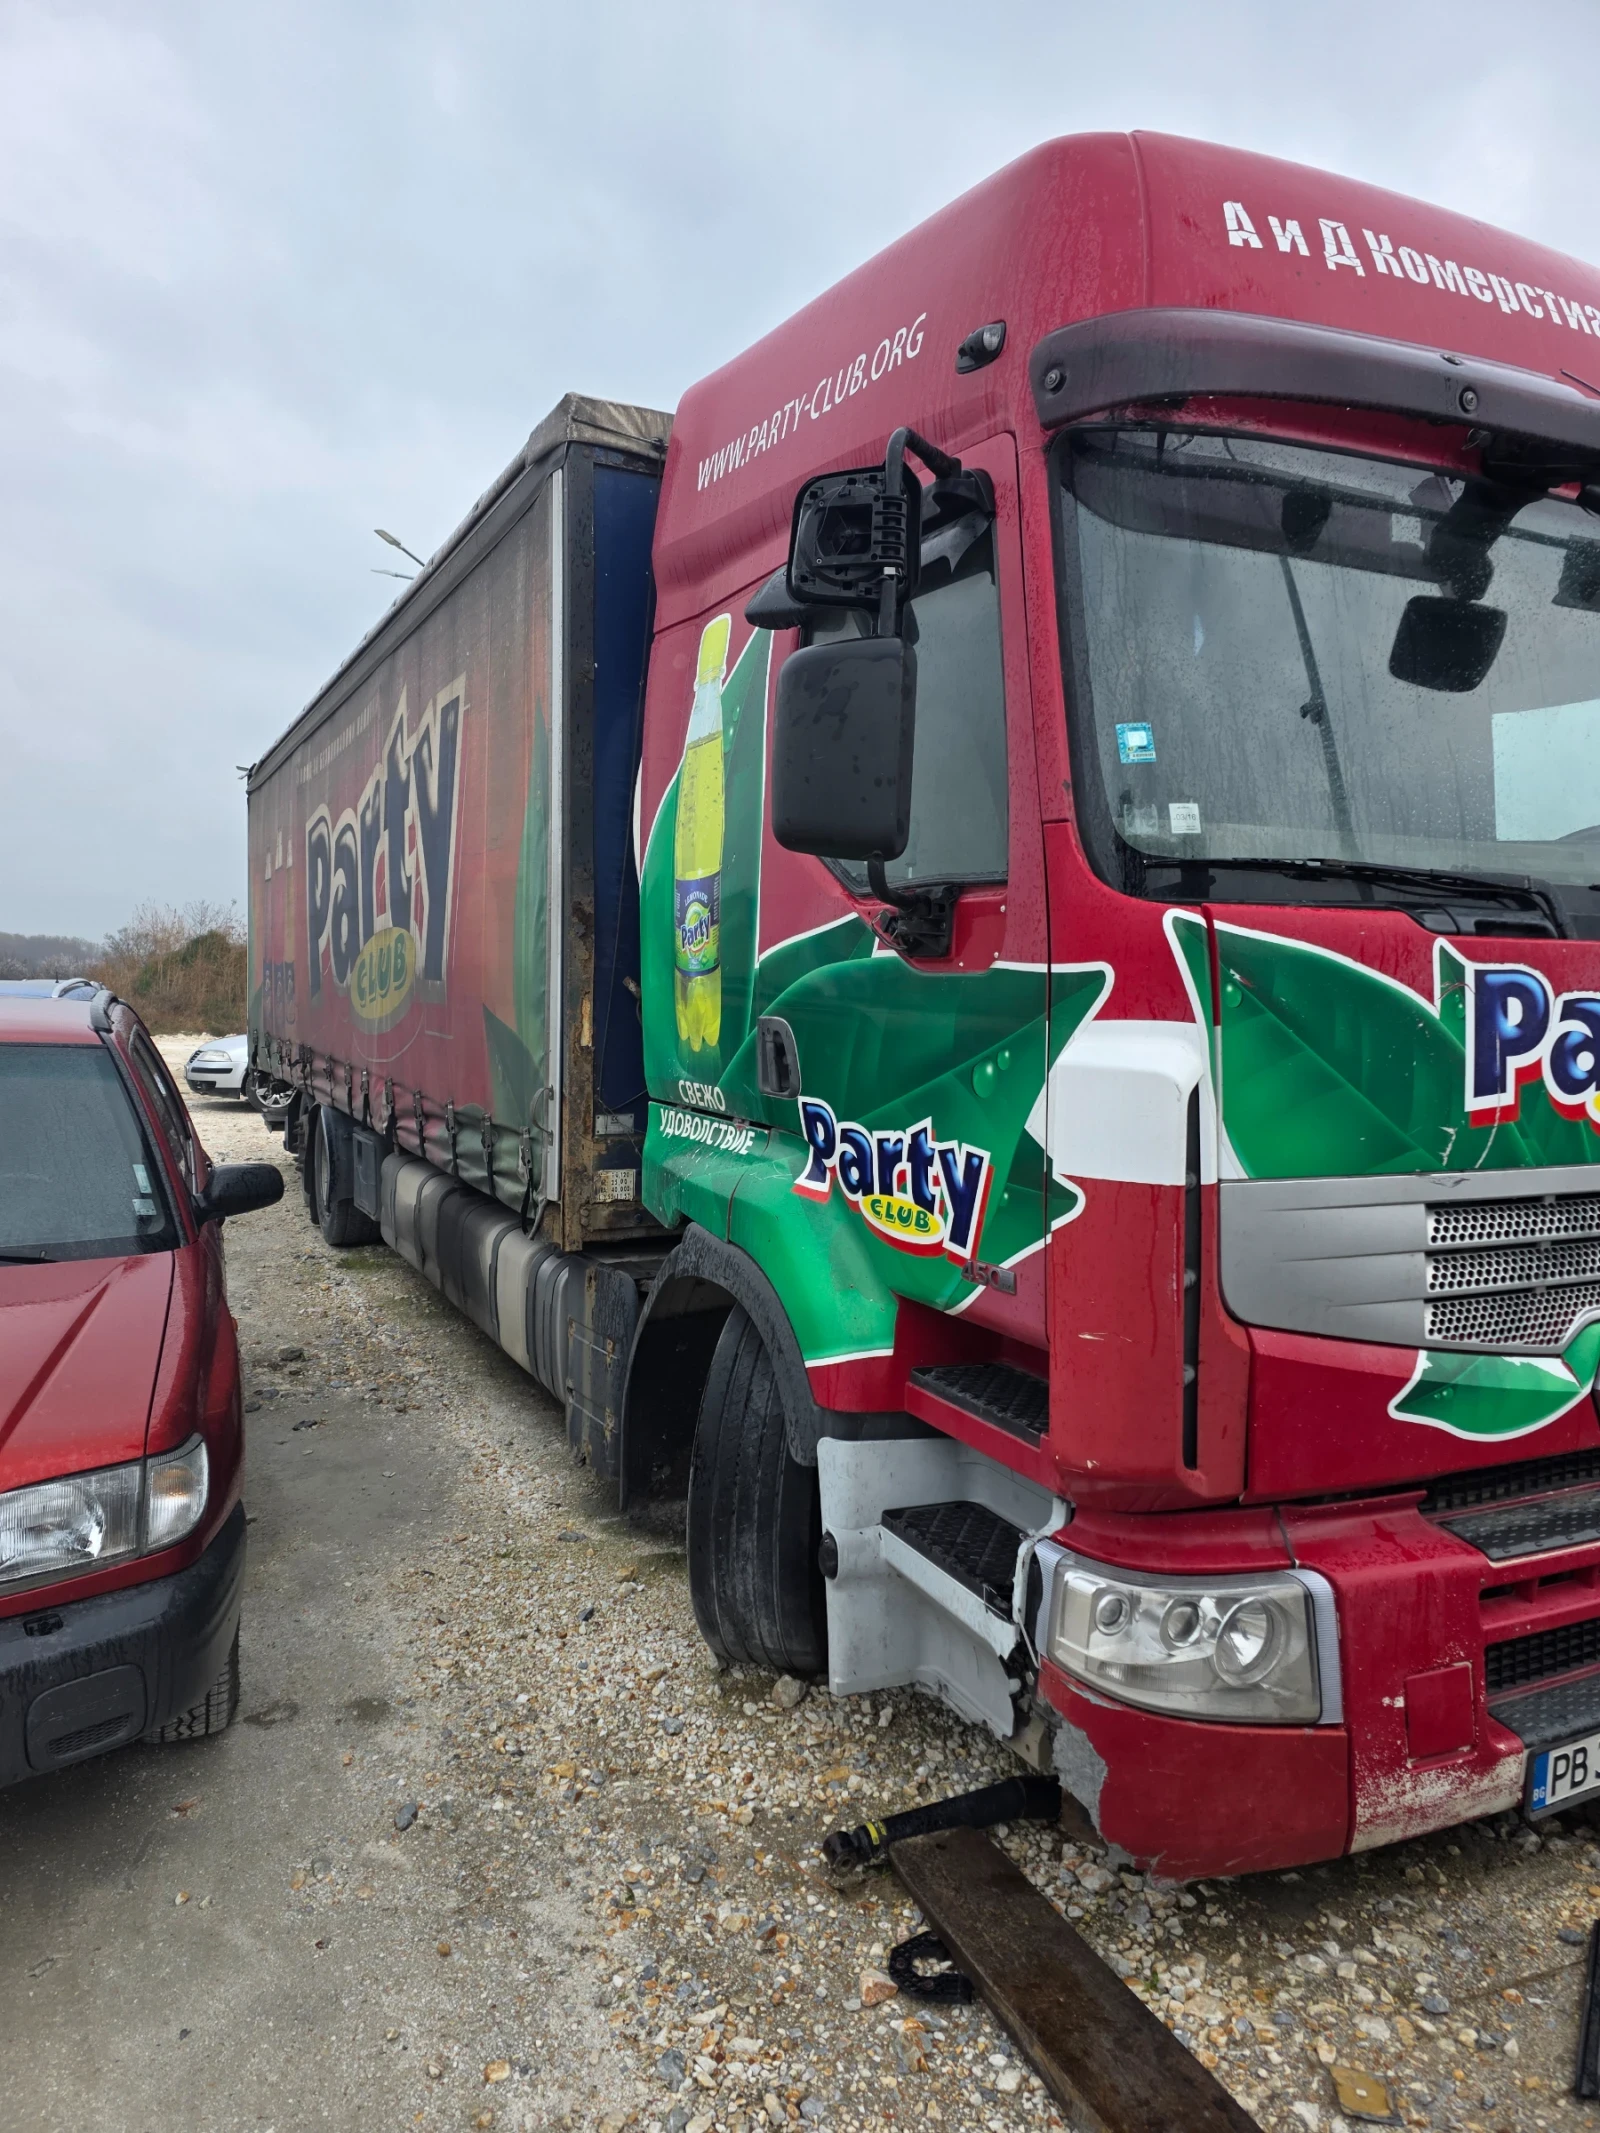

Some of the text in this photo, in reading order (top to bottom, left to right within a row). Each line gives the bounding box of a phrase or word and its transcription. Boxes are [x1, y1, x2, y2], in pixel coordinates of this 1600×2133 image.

[1223, 201, 1263, 249] А
[1267, 215, 1310, 256] и
[1317, 217, 1366, 277] Д
[697, 312, 927, 492] WWW.PARTY-CLUB.ORG
[305, 672, 467, 1002] Party
[681, 912, 711, 952] Party
[356, 932, 407, 1007] CLUB
[678, 1079, 726, 1112] СВЕЖО
[660, 1108, 755, 1156] УДОВОЛСТВИЕ
[794, 1096, 991, 1259] Party
[870, 1198, 931, 1233] CLUB
[961, 1260, 1000, 1290] 450
[1532, 1786, 1546, 1802] BG
